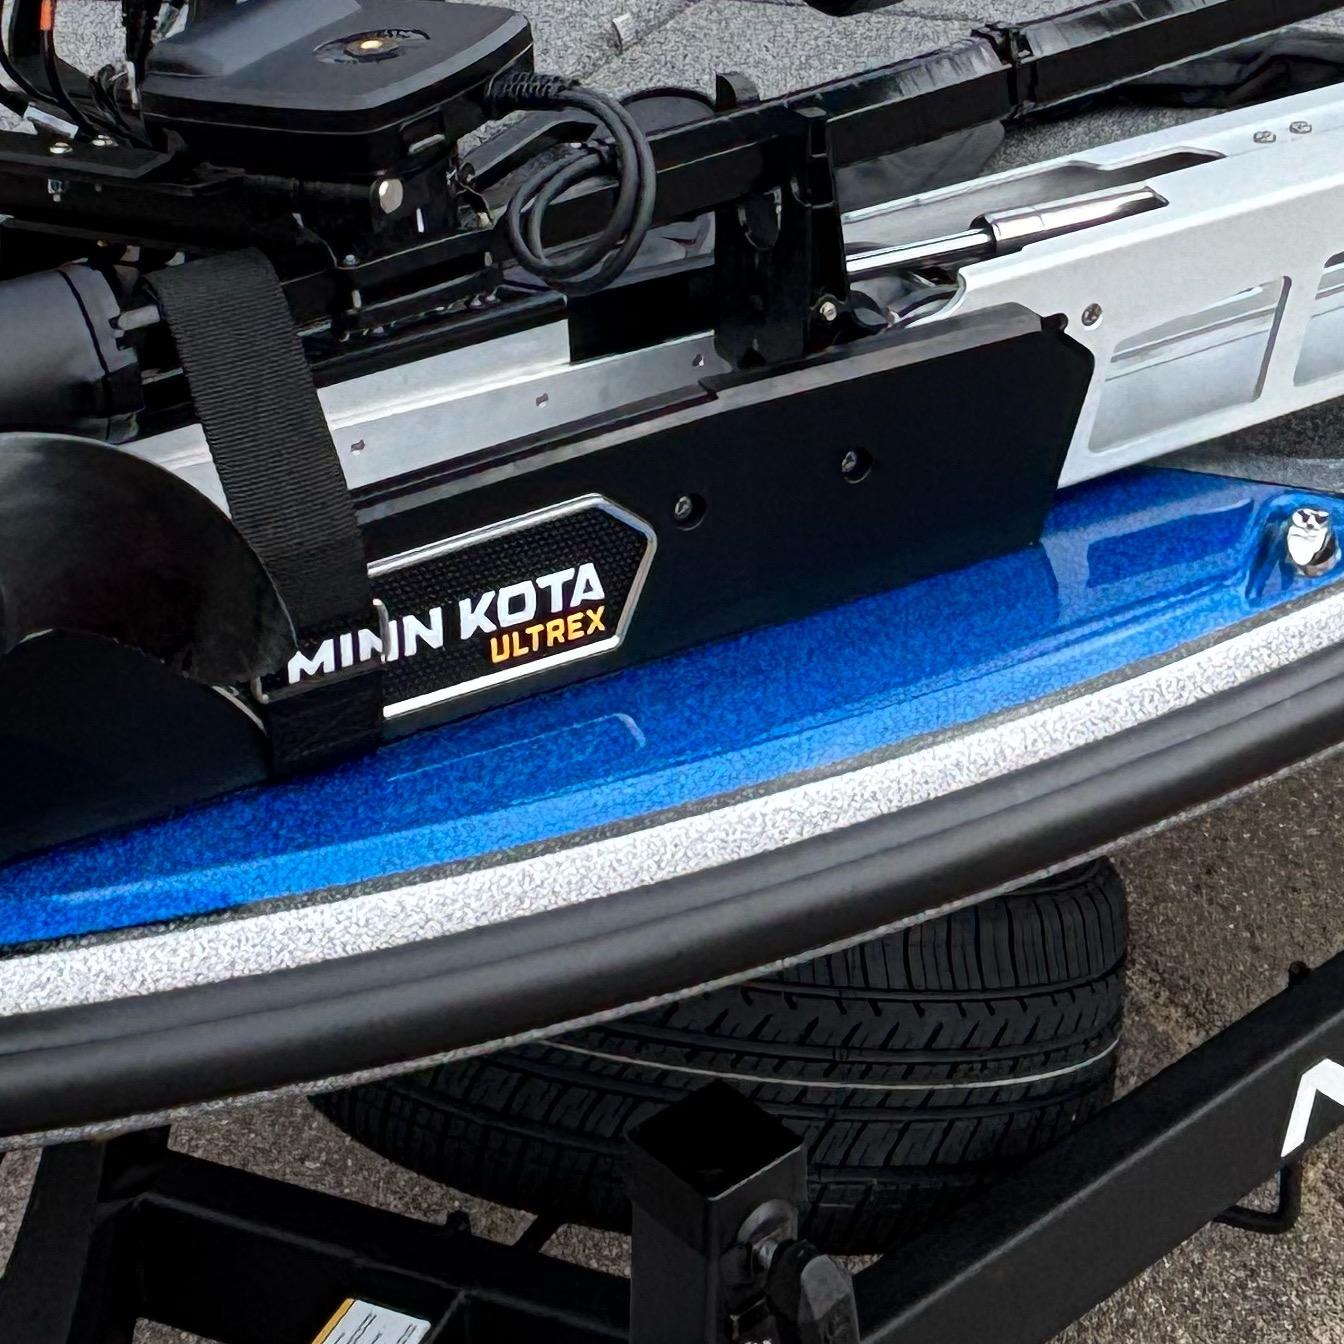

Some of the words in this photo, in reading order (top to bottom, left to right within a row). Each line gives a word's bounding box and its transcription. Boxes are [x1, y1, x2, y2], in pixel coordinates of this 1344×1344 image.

[288, 606, 444, 684] MINN
[458, 562, 606, 641] KOTA
[490, 605, 606, 664] ULTREX
